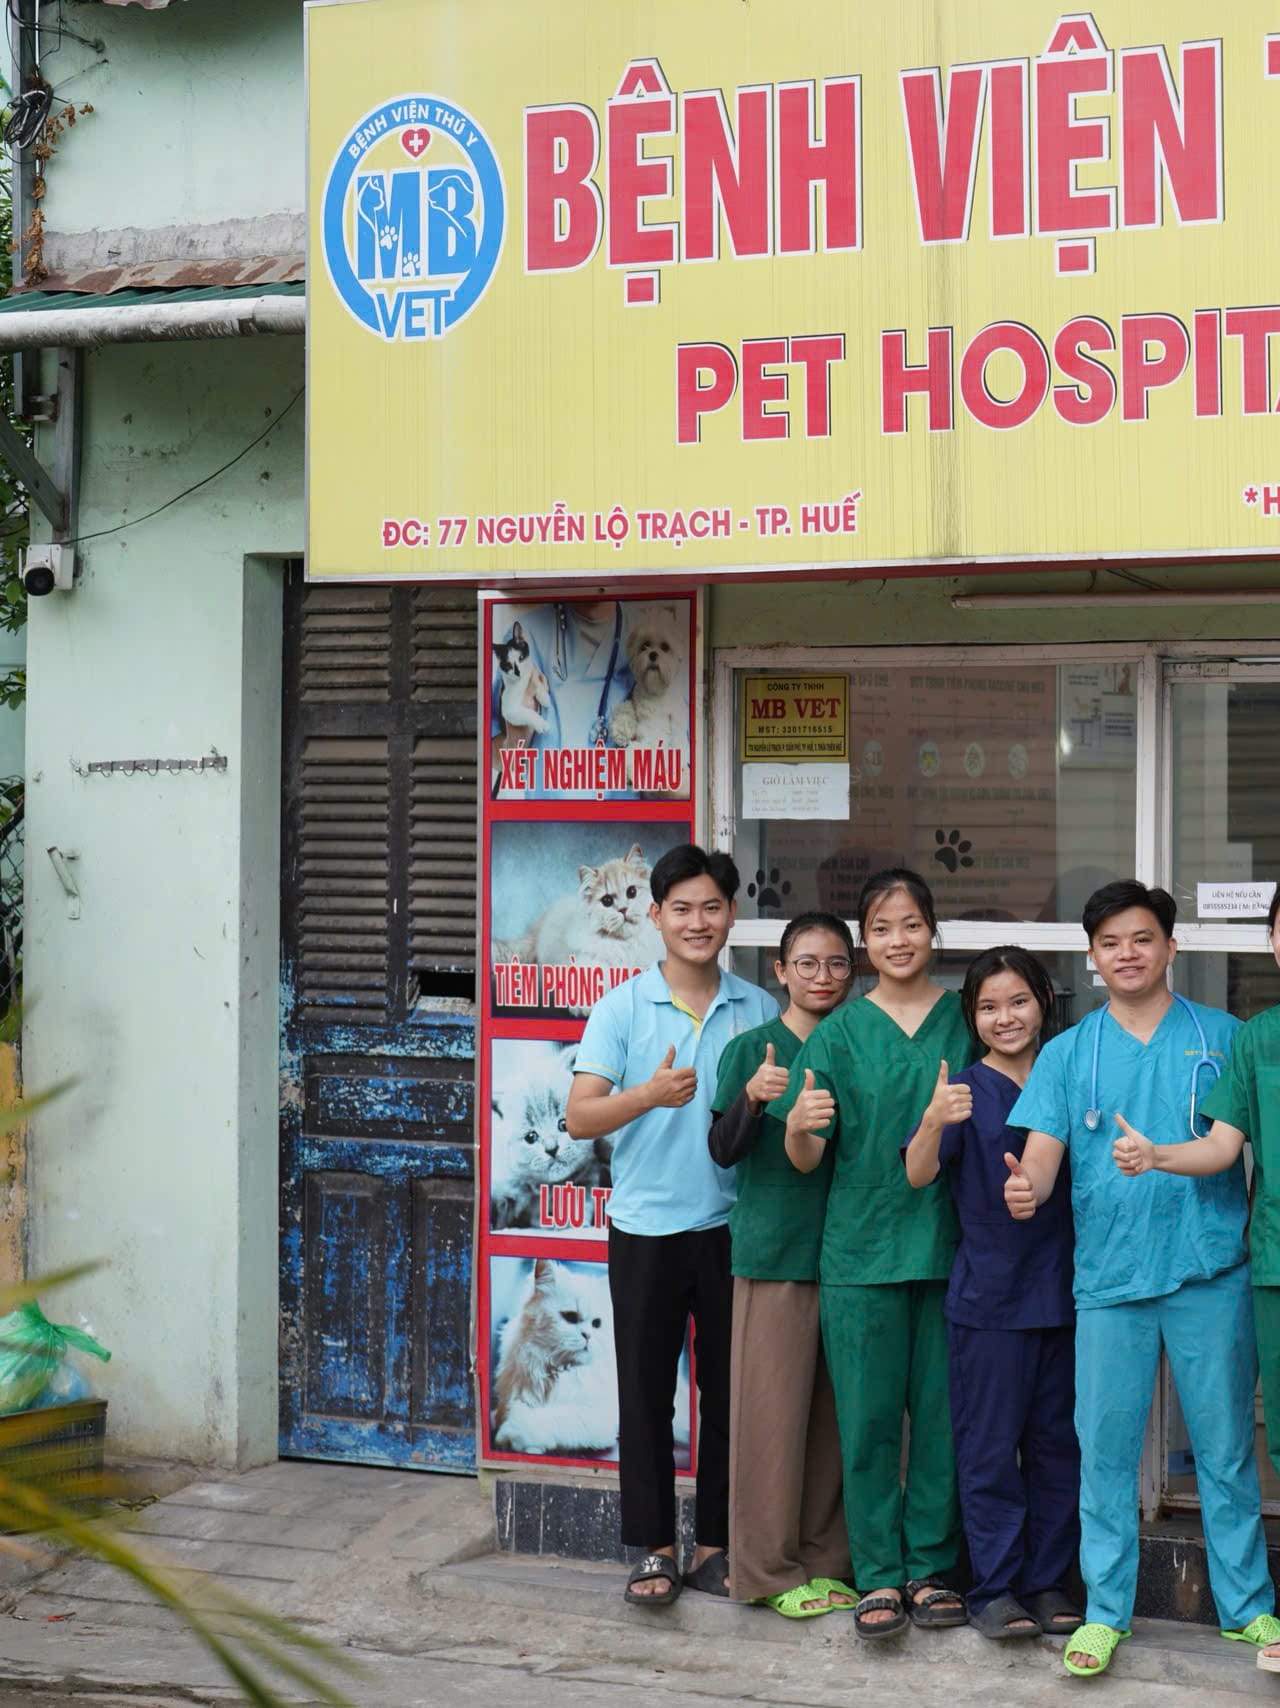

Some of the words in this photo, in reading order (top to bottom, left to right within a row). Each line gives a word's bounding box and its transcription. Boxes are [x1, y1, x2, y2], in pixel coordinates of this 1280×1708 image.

[348, 114, 388, 159] BỆNH
[391, 100, 430, 124] VIỆN
[434, 107, 467, 135] THÚ
[466, 132, 479, 148] Y
[524, 60, 861, 305] BỆNH
[902, 15, 1222, 274] VIỆN
[357, 168, 477, 281] MB
[375, 288, 452, 338] VET
[678, 335, 844, 443] PET
[383, 518, 429, 547] ĐC:
[438, 518, 468, 545] 77
[477, 503, 585, 545] NGUYỄN
[594, 506, 628, 549] LỘ
[636, 509, 731, 548] TRẠCH
[756, 507, 791, 536] TP.
[802, 490, 862, 534] HUẾ
[751, 698, 786, 719] MB
[793, 697, 841, 719] VET
[768, 682, 789, 691] CÔNG
[792, 682, 801, 691] TY
[804, 682, 824, 691] TNHH
[500, 740, 536, 790] XÉT
[544, 740, 626, 799] NGHIỆM
[633, 740, 682, 791] MÁU
[494, 956, 538, 1006] TIÊM
[543, 956, 604, 1007] PHÒNG
[540, 1182, 585, 1228] LƯU
